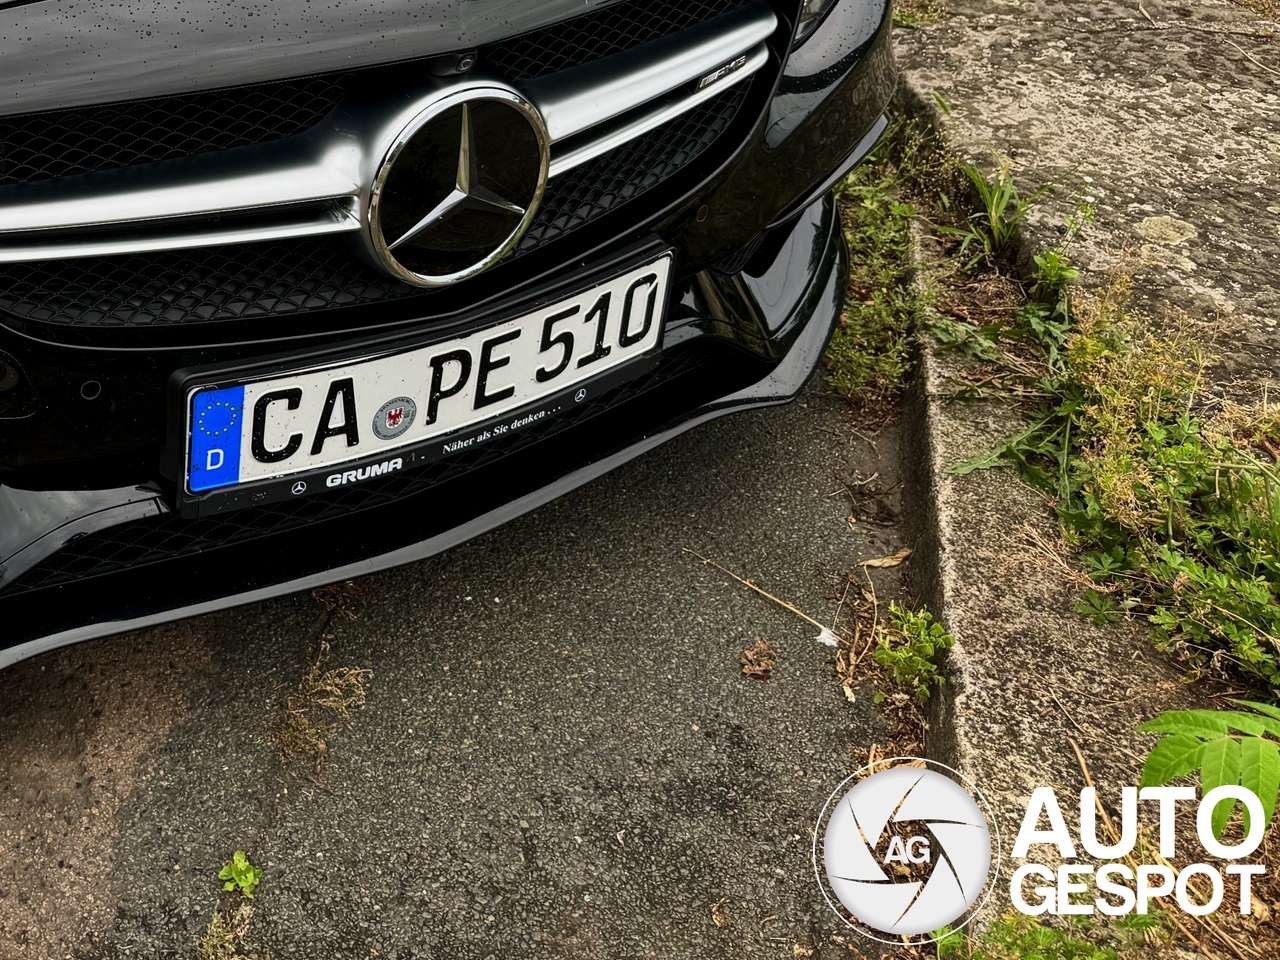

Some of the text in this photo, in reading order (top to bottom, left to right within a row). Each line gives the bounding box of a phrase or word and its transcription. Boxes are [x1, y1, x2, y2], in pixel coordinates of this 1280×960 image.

[206, 272, 659, 471] D CA PE 510
[442, 438, 475, 455] Näher
[476, 430, 491, 443] als
[492, 423, 509, 437] Sie
[510, 409, 546, 429] denken
[325, 457, 403, 488] GRUMA
